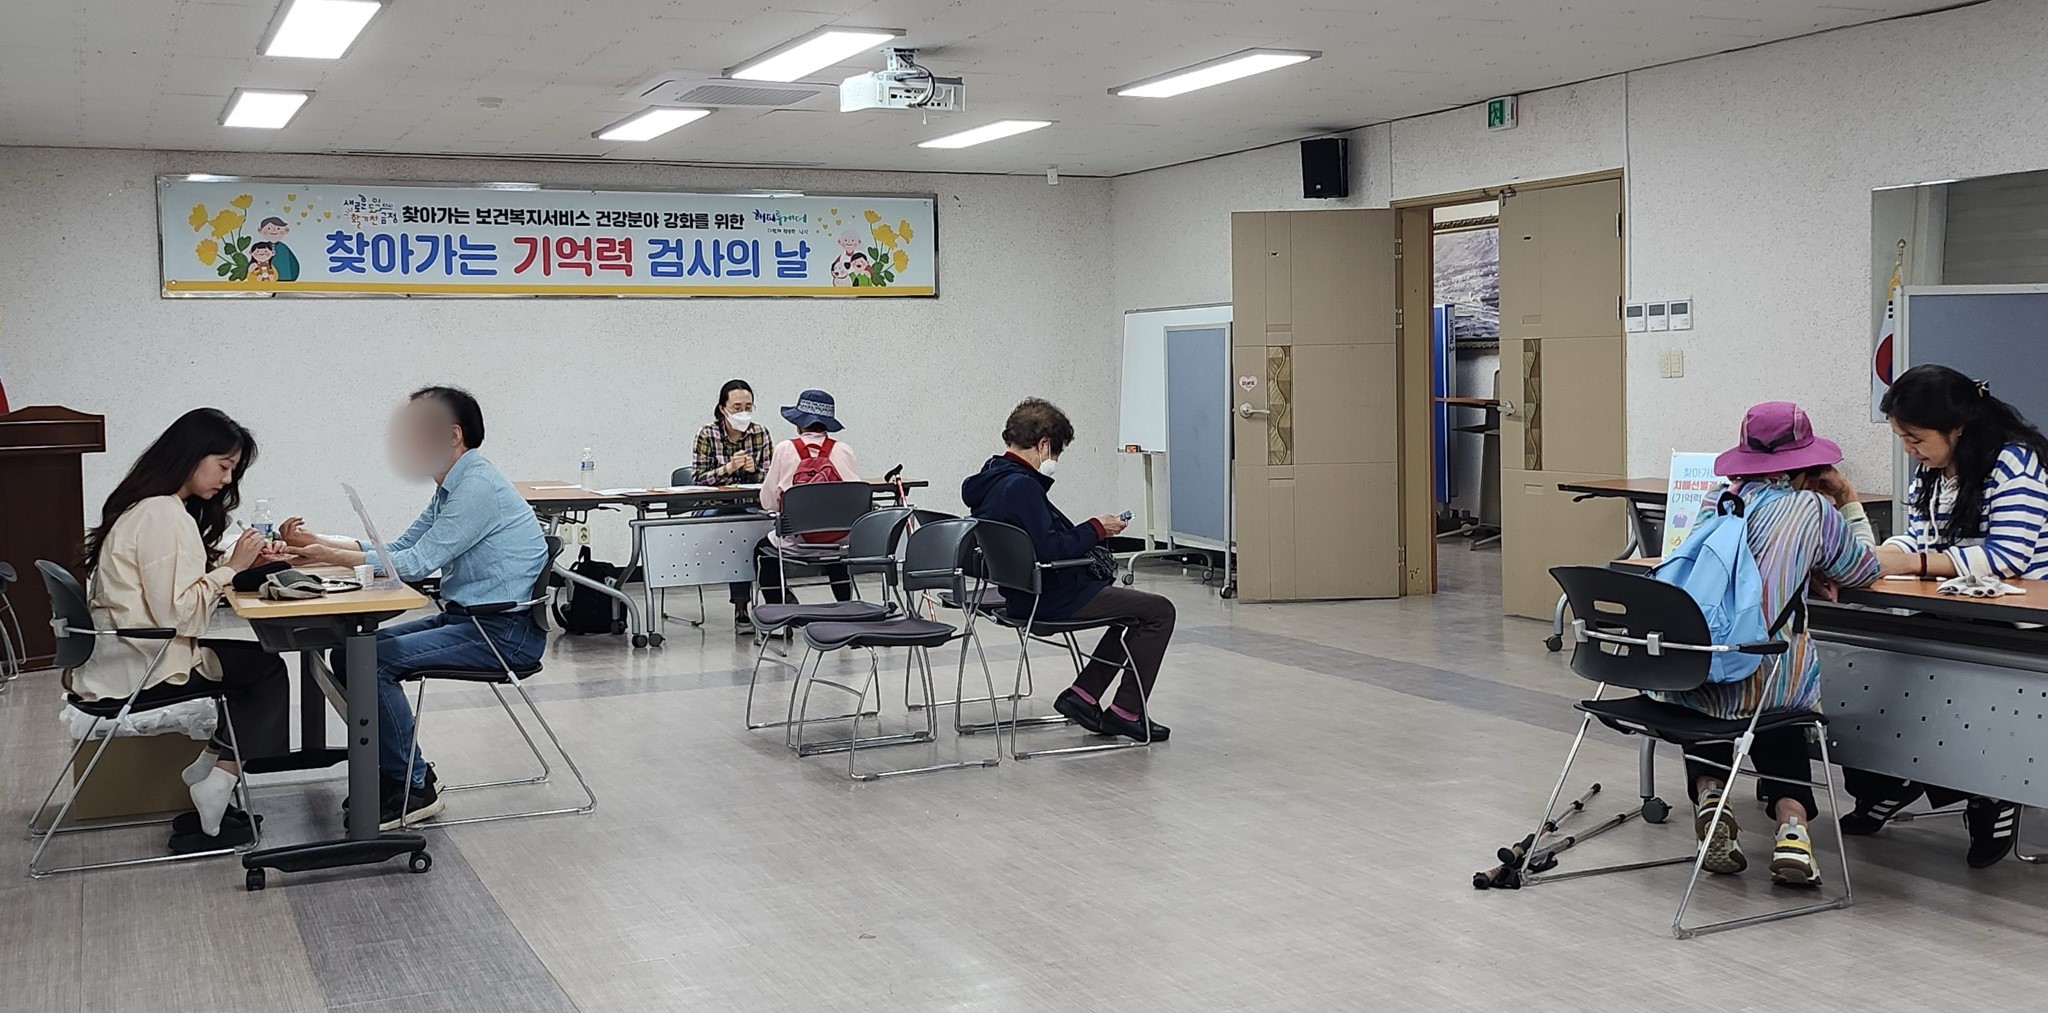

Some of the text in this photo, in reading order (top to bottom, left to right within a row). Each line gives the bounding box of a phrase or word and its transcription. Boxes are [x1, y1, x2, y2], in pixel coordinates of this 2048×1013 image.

[381, 212, 398, 224] 금정
[402, 205, 745, 230] 찾아가는 보건복지서비스 건강분야 강화를 위한
[326, 230, 811, 278] 찾아가는 기억력 검사의 날
